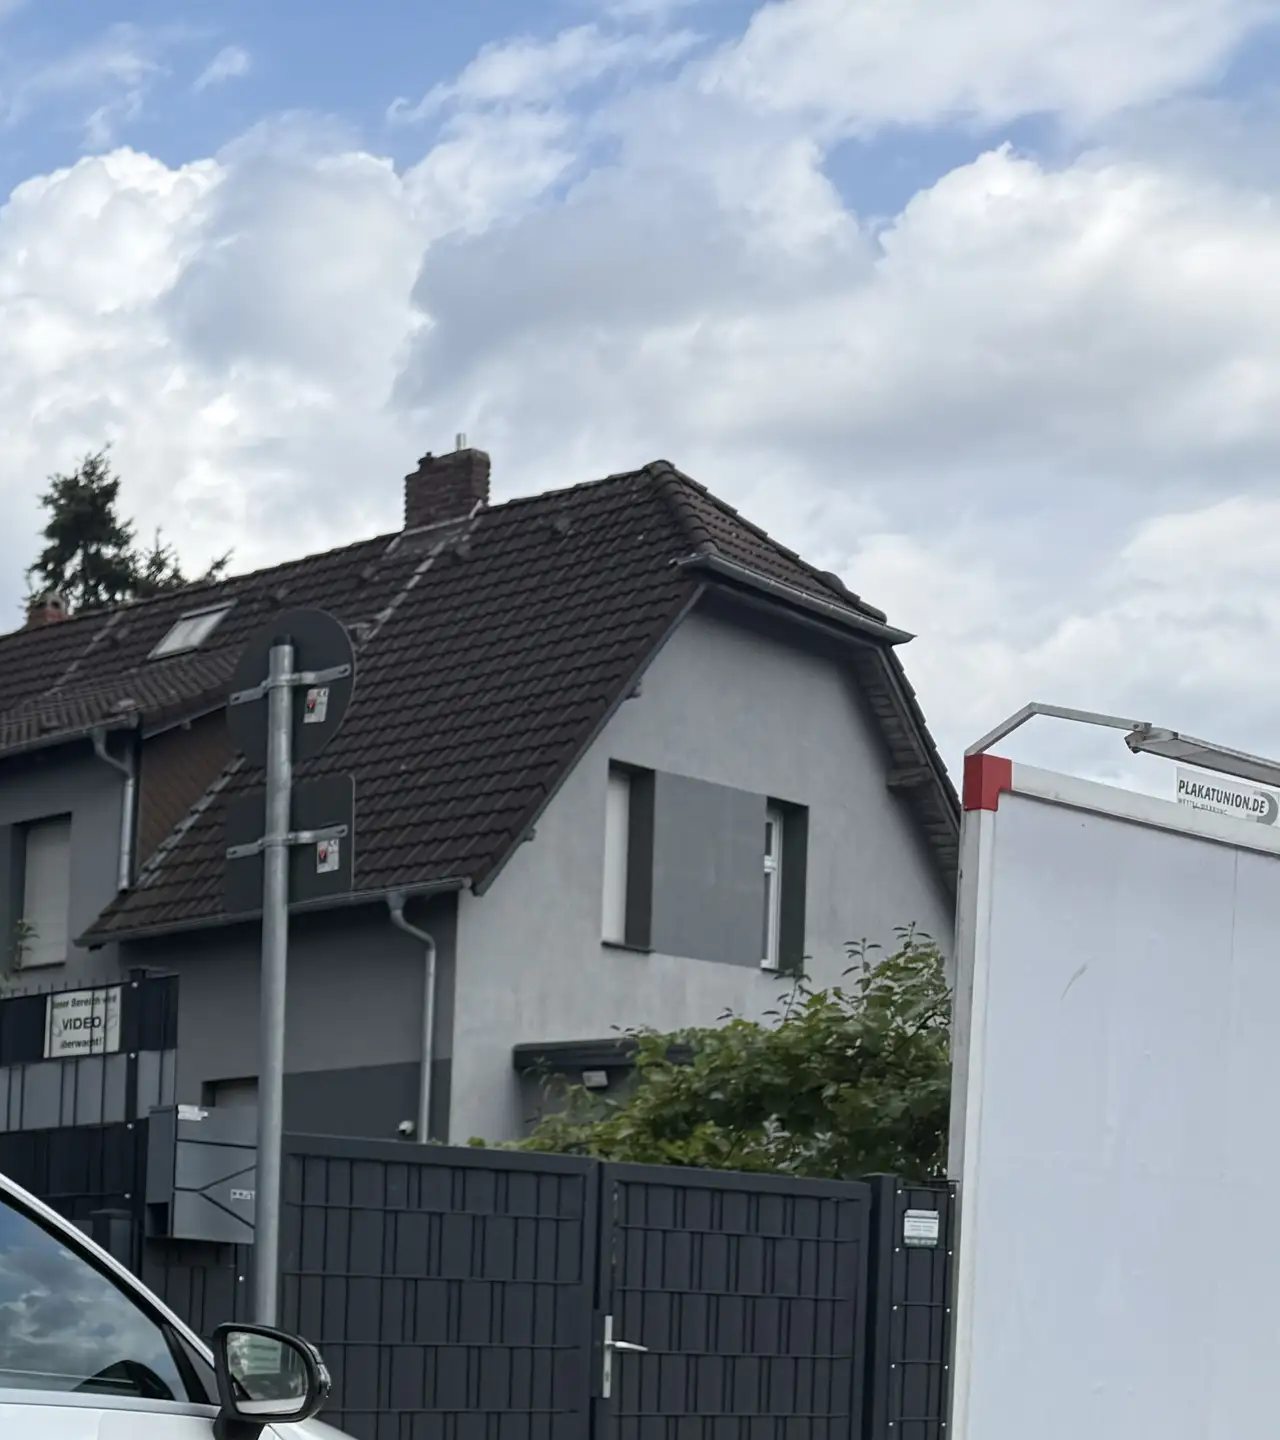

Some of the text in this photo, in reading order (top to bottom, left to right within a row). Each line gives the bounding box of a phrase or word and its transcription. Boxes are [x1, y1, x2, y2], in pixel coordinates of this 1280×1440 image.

[1178, 779, 1266, 814] PLAKATUNION.DE
[71, 997, 101, 1008] Bereih
[62, 1016, 102, 1031] VIDEO
